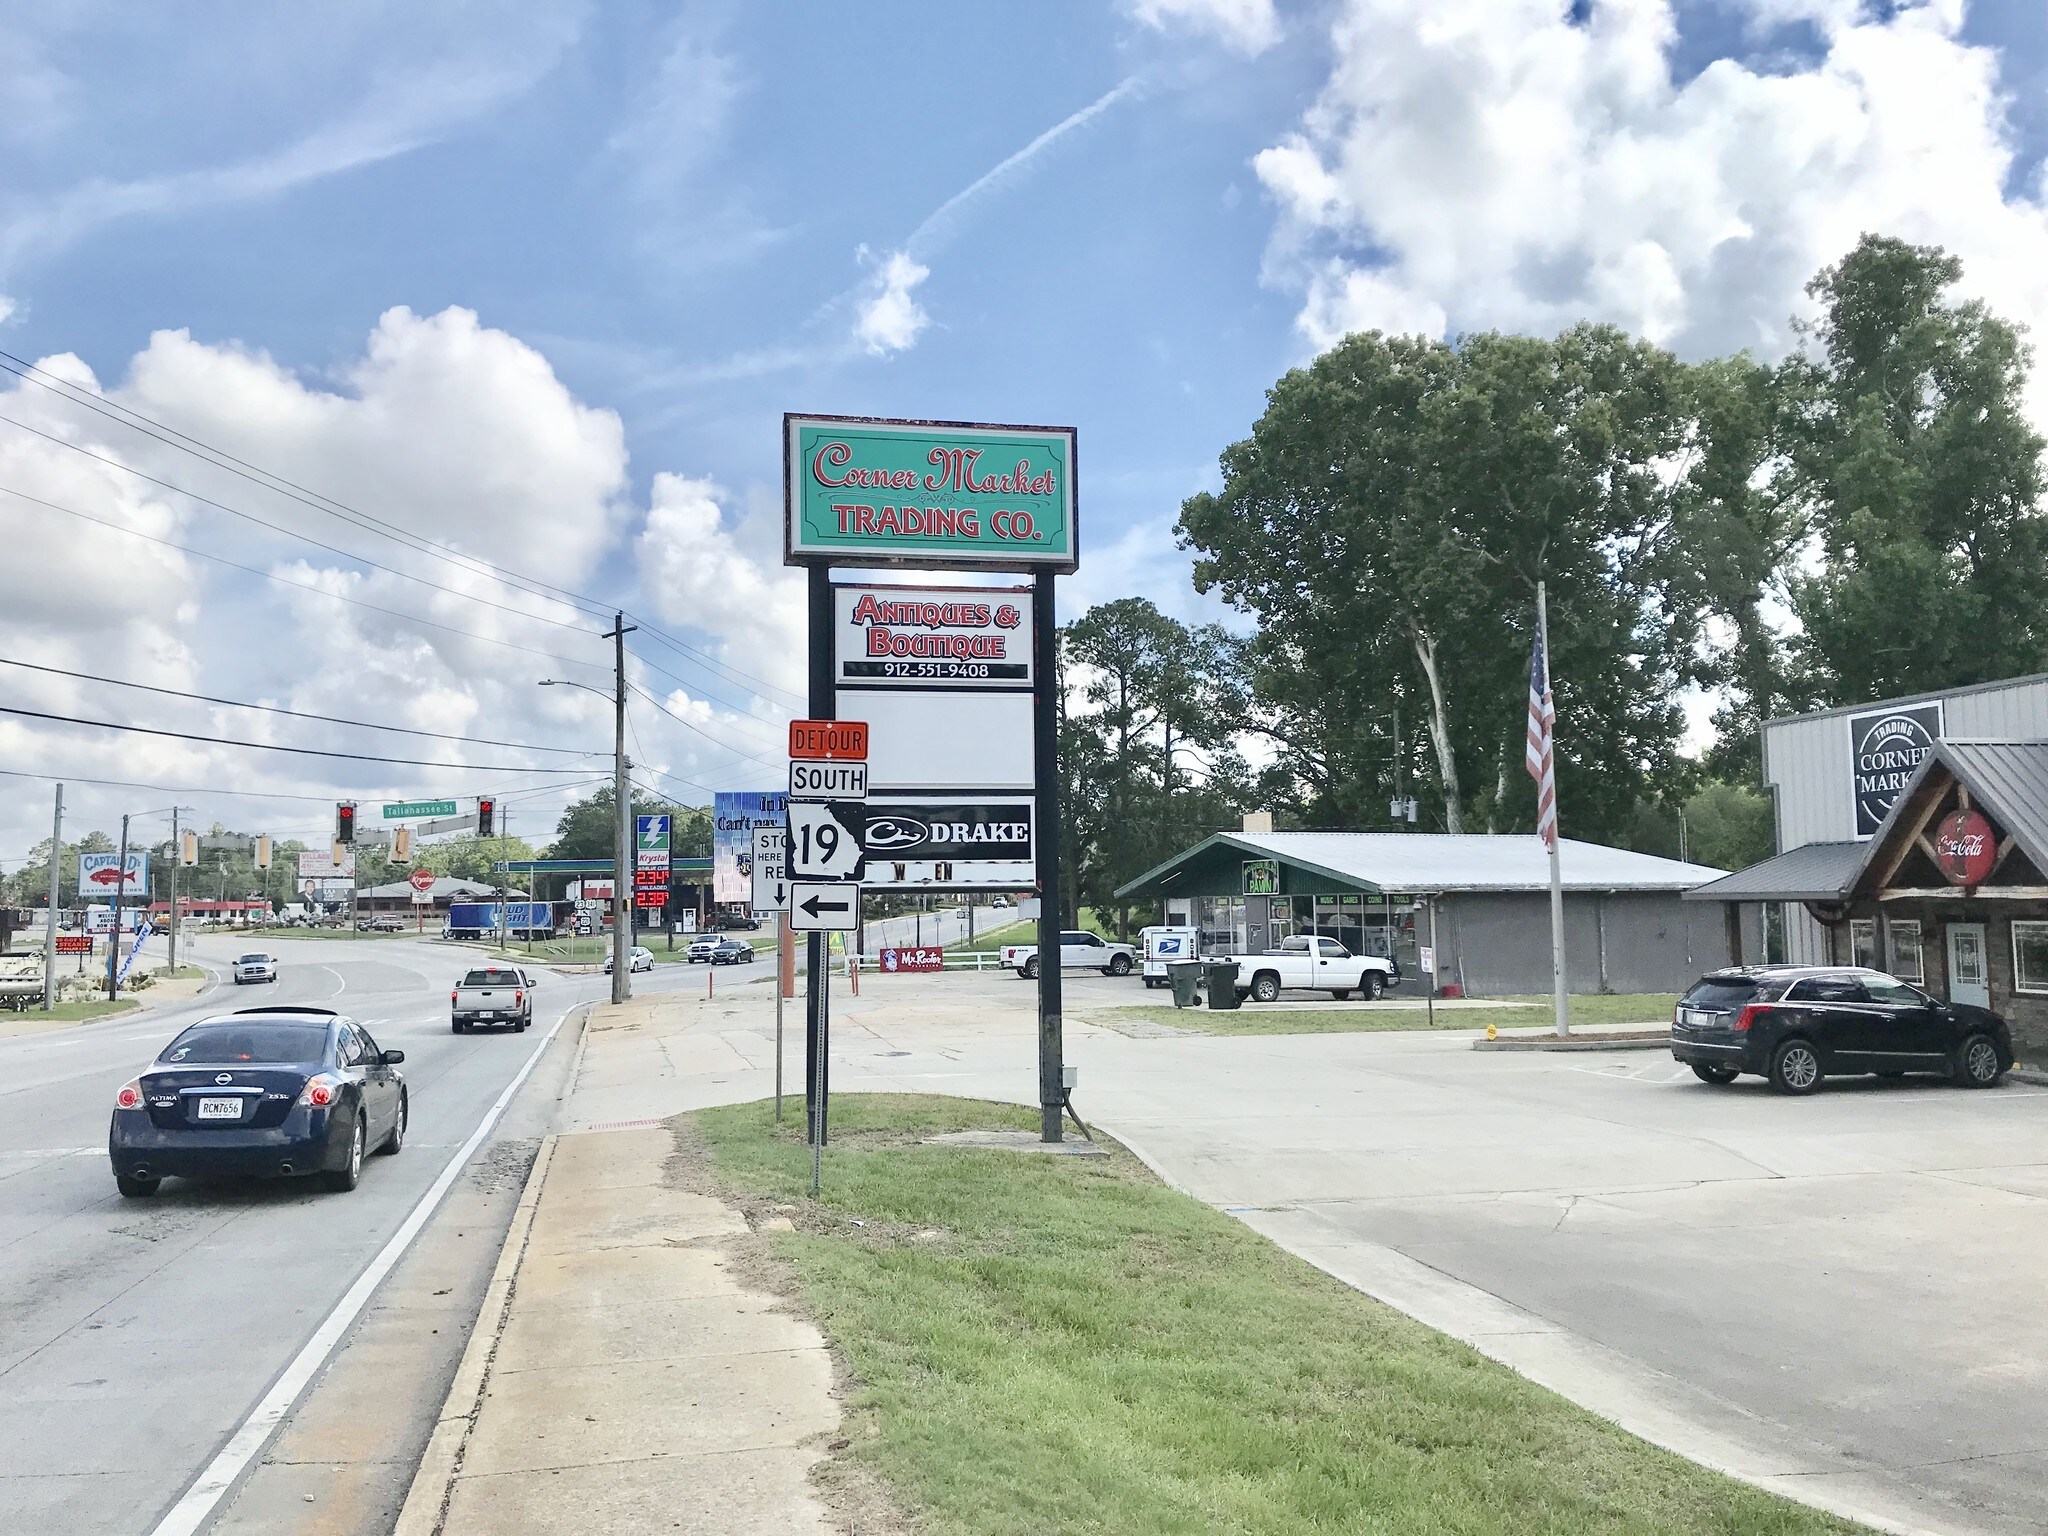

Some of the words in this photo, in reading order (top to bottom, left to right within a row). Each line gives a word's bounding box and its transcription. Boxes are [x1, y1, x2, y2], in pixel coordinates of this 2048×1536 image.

[814, 442, 921, 490] Corner
[923, 447, 1057, 495] Market
[831, 504, 981, 537] TRADING
[991, 510, 1043, 540] CO.
[851, 595, 992, 630] ANTIQUES
[993, 604, 1021, 629] &
[866, 627, 1007, 662] BOUTIQUE
[884, 663, 989, 678] 912-551-9408
[795, 729, 862, 751] DETOUR
[1873, 721, 1914, 741] TRADING
[793, 766, 864, 791] SOUTH
[1860, 771, 1912, 793] MARK
[387, 806, 440, 816] Tallahassee
[443, 804, 453, 812] St
[760, 834, 787, 849] STO
[930, 822, 1029, 843] DRAKE
[800, 823, 839, 864] 19
[84, 855, 120, 871] CAPTAI
[639, 854, 668, 864] Krystal
[758, 853, 782, 861] HERE
[765, 866, 785, 879] RE
[1250, 879, 1272, 892] PAWN
[916, 950, 942, 965] Rooter
[203, 1103, 239, 1114] RCM7656
